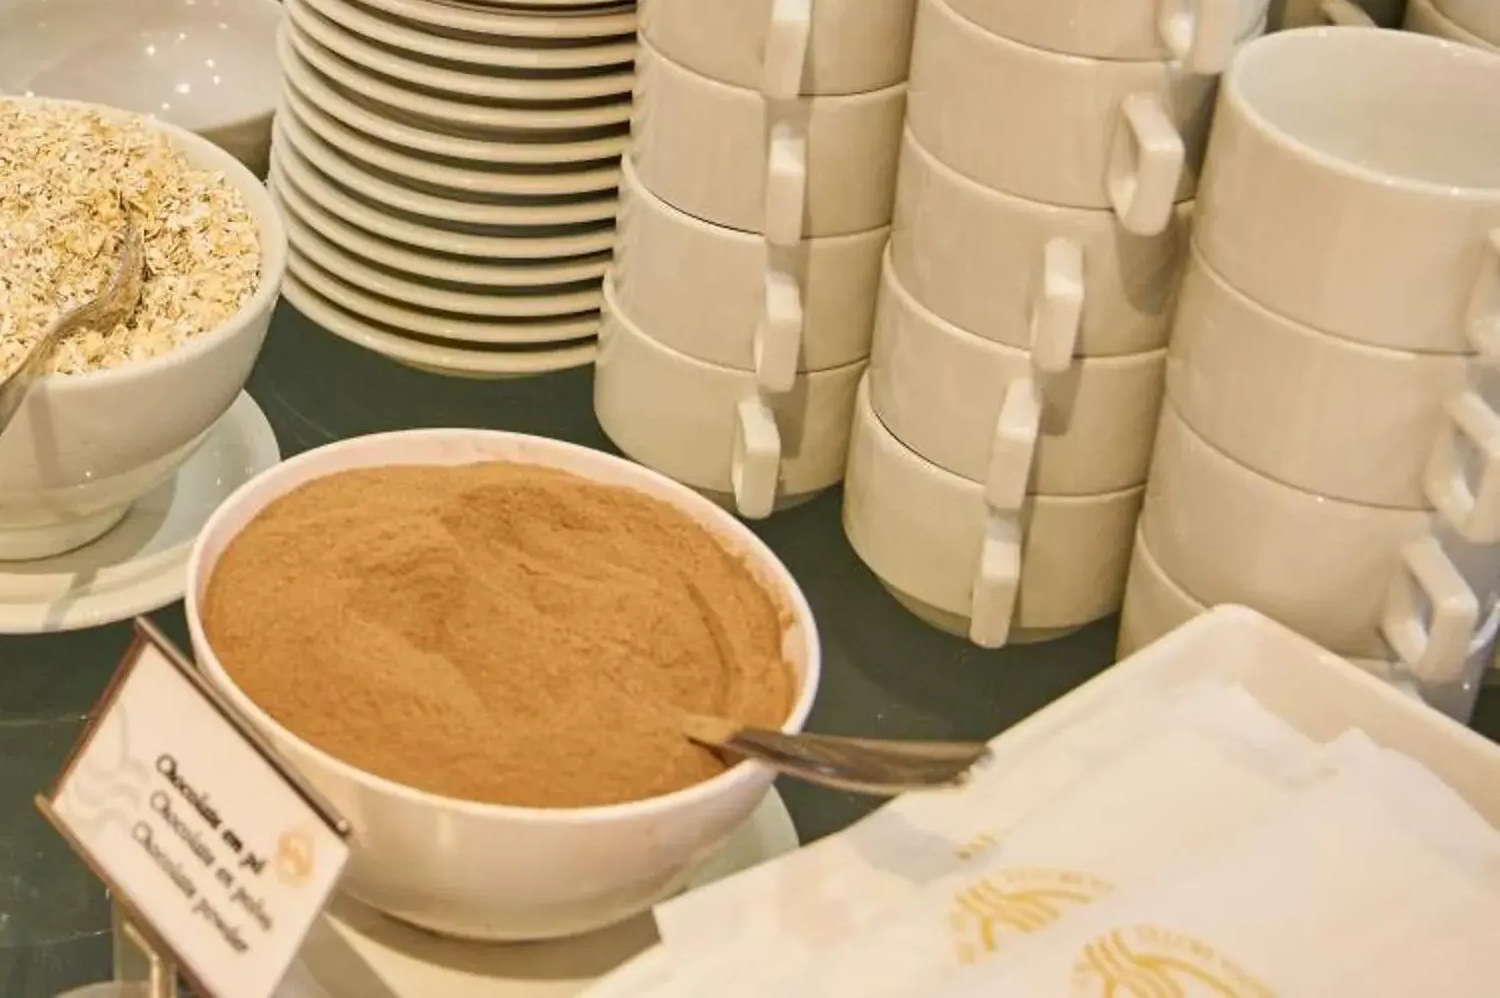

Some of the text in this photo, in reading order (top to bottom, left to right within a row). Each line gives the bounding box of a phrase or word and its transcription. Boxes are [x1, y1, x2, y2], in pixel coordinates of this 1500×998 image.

[149, 789, 216, 867] Chocolate
[156, 754, 222, 829] Chocolate
[222, 829, 244, 854] em
[131, 820, 197, 900] Chocolate
